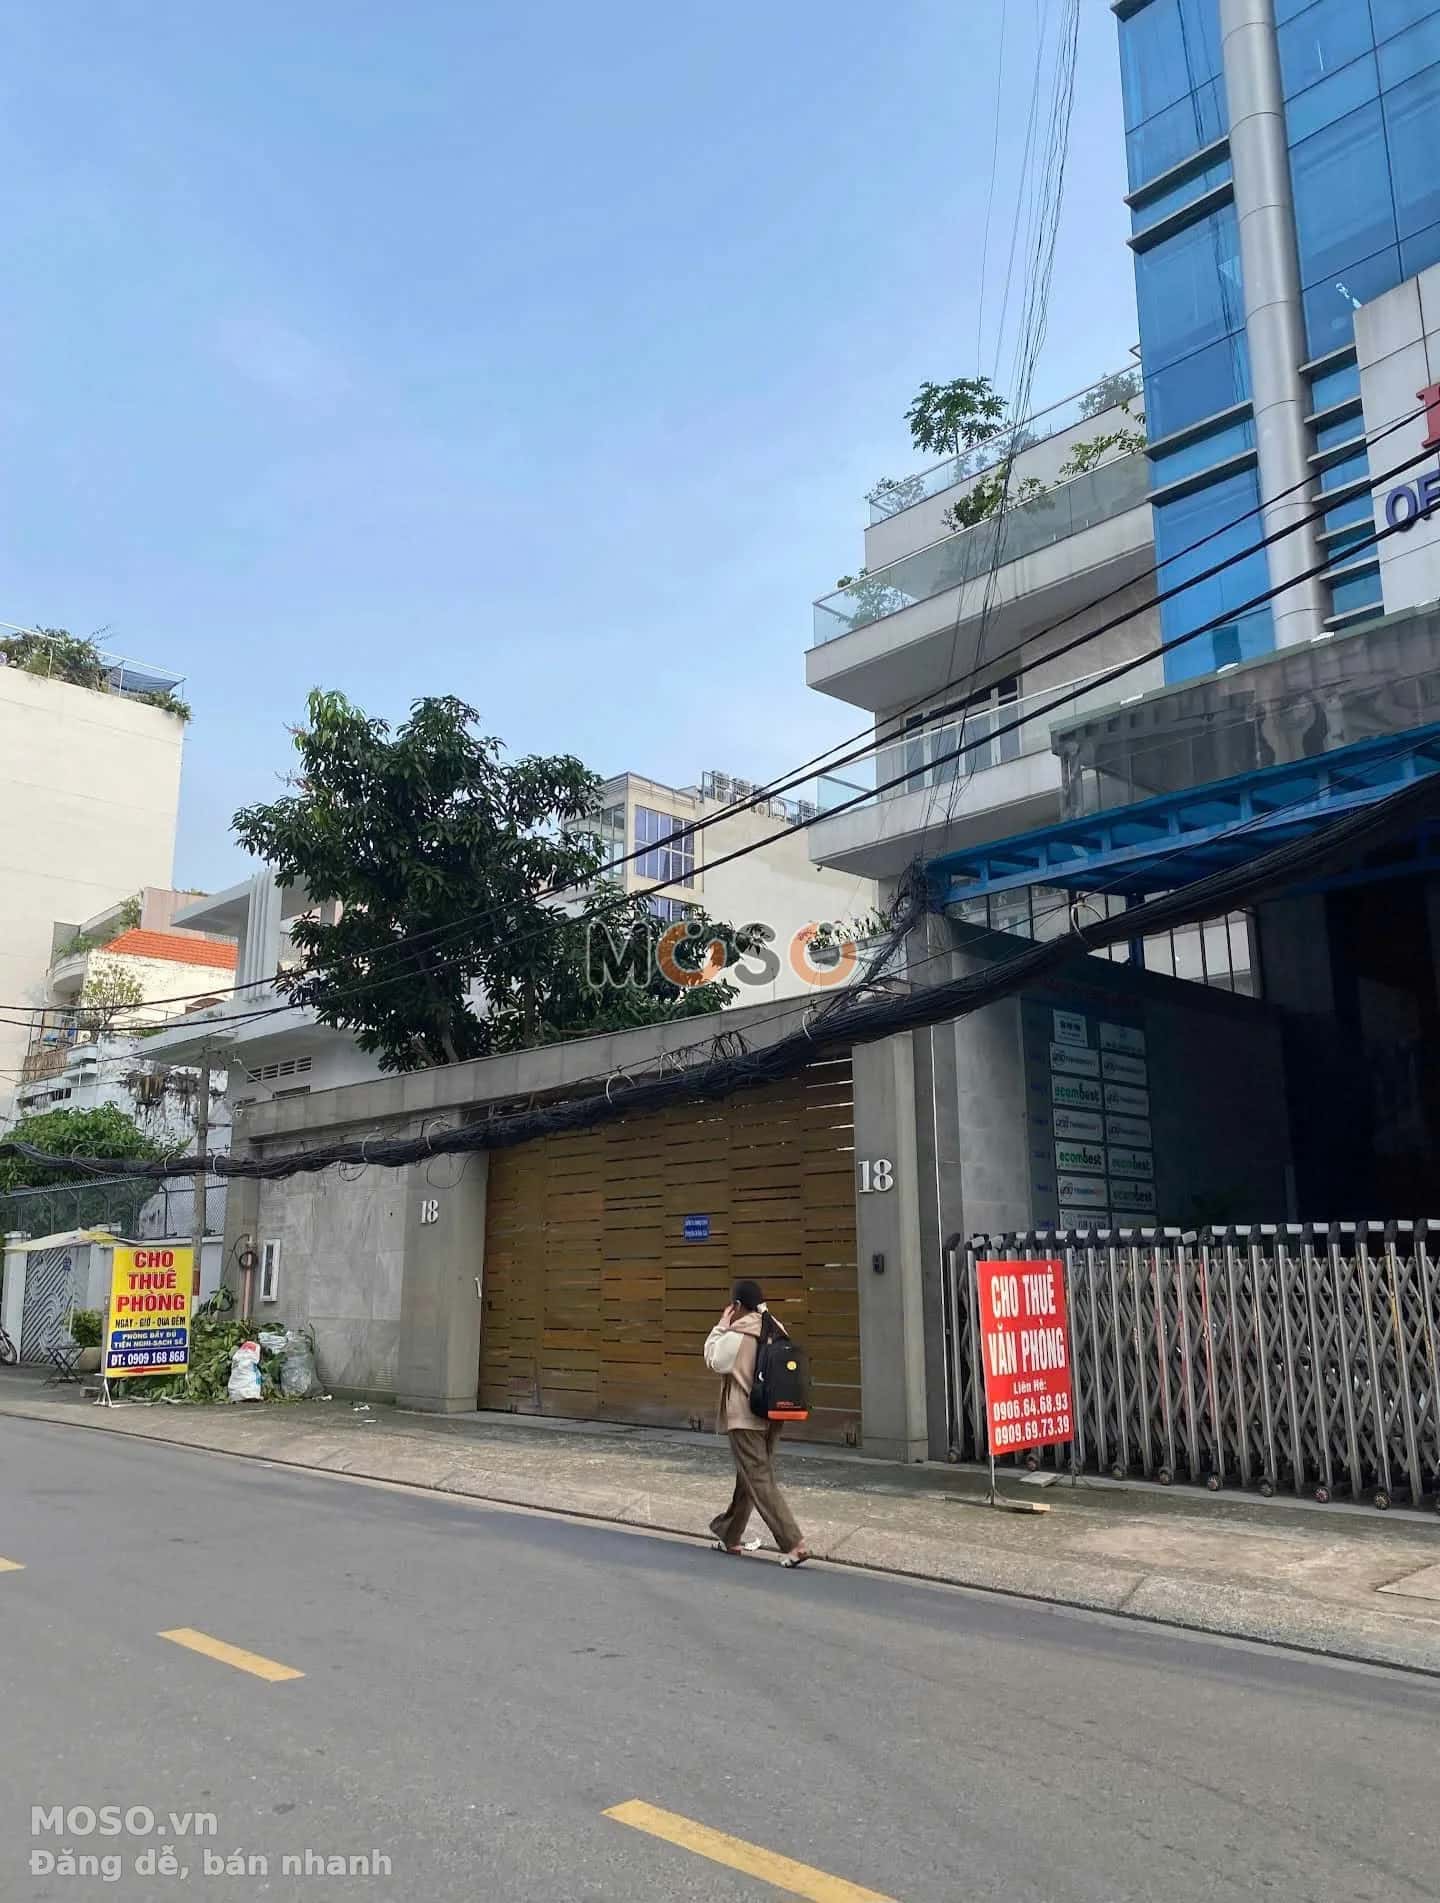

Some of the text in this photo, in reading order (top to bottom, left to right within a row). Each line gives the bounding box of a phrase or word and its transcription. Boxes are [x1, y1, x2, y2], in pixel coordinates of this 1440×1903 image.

[1059, 1147, 1101, 1166] ecombest
[858, 1159, 894, 1192] 18
[419, 1200, 439, 1224] 18
[134, 1251, 174, 1268] CHO
[128, 1269, 177, 1290] THUÊ
[116, 1292, 185, 1313] PHÒNG
[991, 1265, 1056, 1319] CHO THUÊ
[127, 1352, 149, 1365] 0909
[151, 1351, 167, 1364] 168
[168, 1350, 185, 1363] 868
[988, 1320, 1065, 1376] VĂN PHÒNG
[1013, 1380, 1032, 1395] Liên
[993, 1392, 1068, 1422] 0906.64.68.93
[995, 1415, 1070, 1446] 0909.69.73.39
